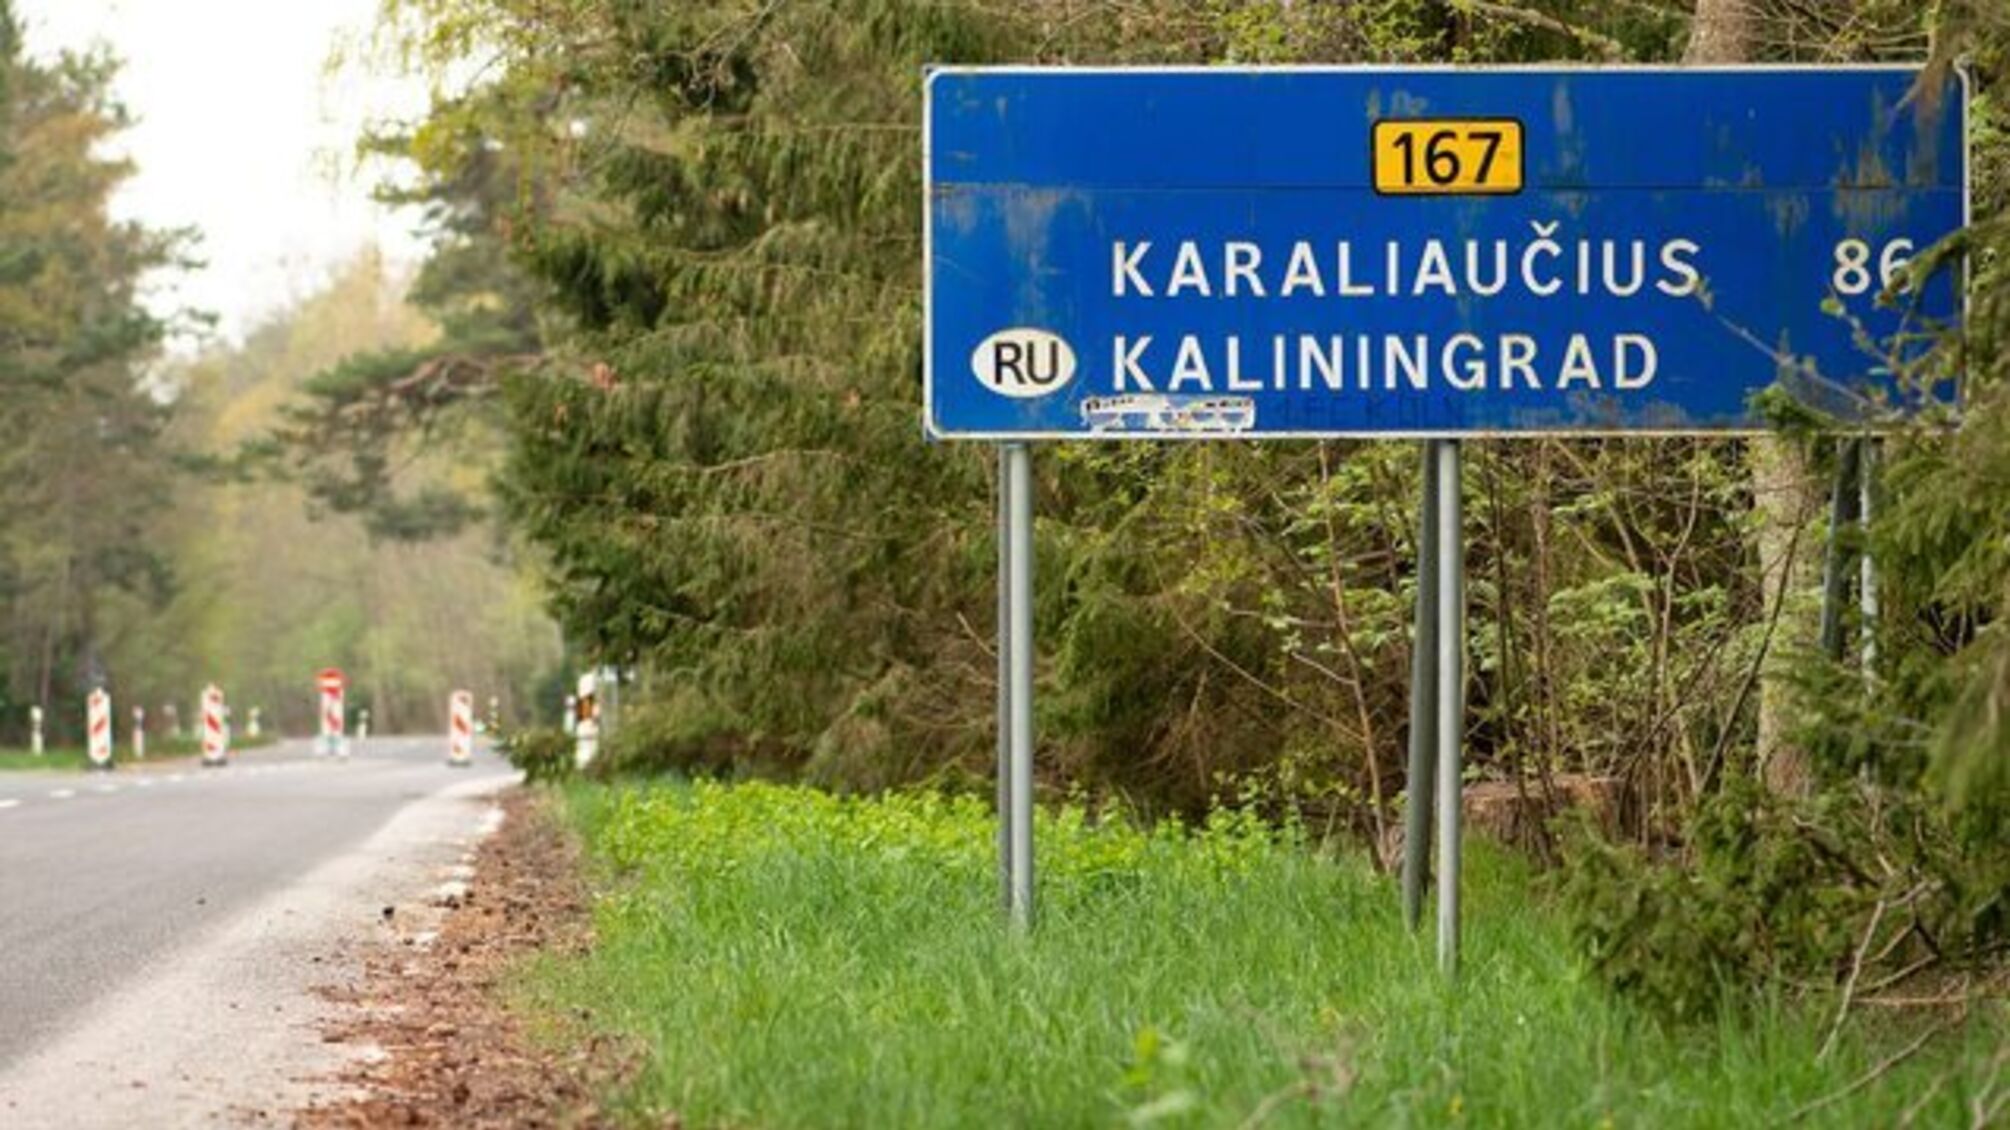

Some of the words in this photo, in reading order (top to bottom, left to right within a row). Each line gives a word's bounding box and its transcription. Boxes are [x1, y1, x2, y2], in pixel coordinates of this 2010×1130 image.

[1391, 130, 1502, 185] 167
[1112, 220, 1700, 297] KARALIAUČIUS
[994, 340, 1060, 385] RU
[1114, 333, 1658, 391] KALININGRAD
